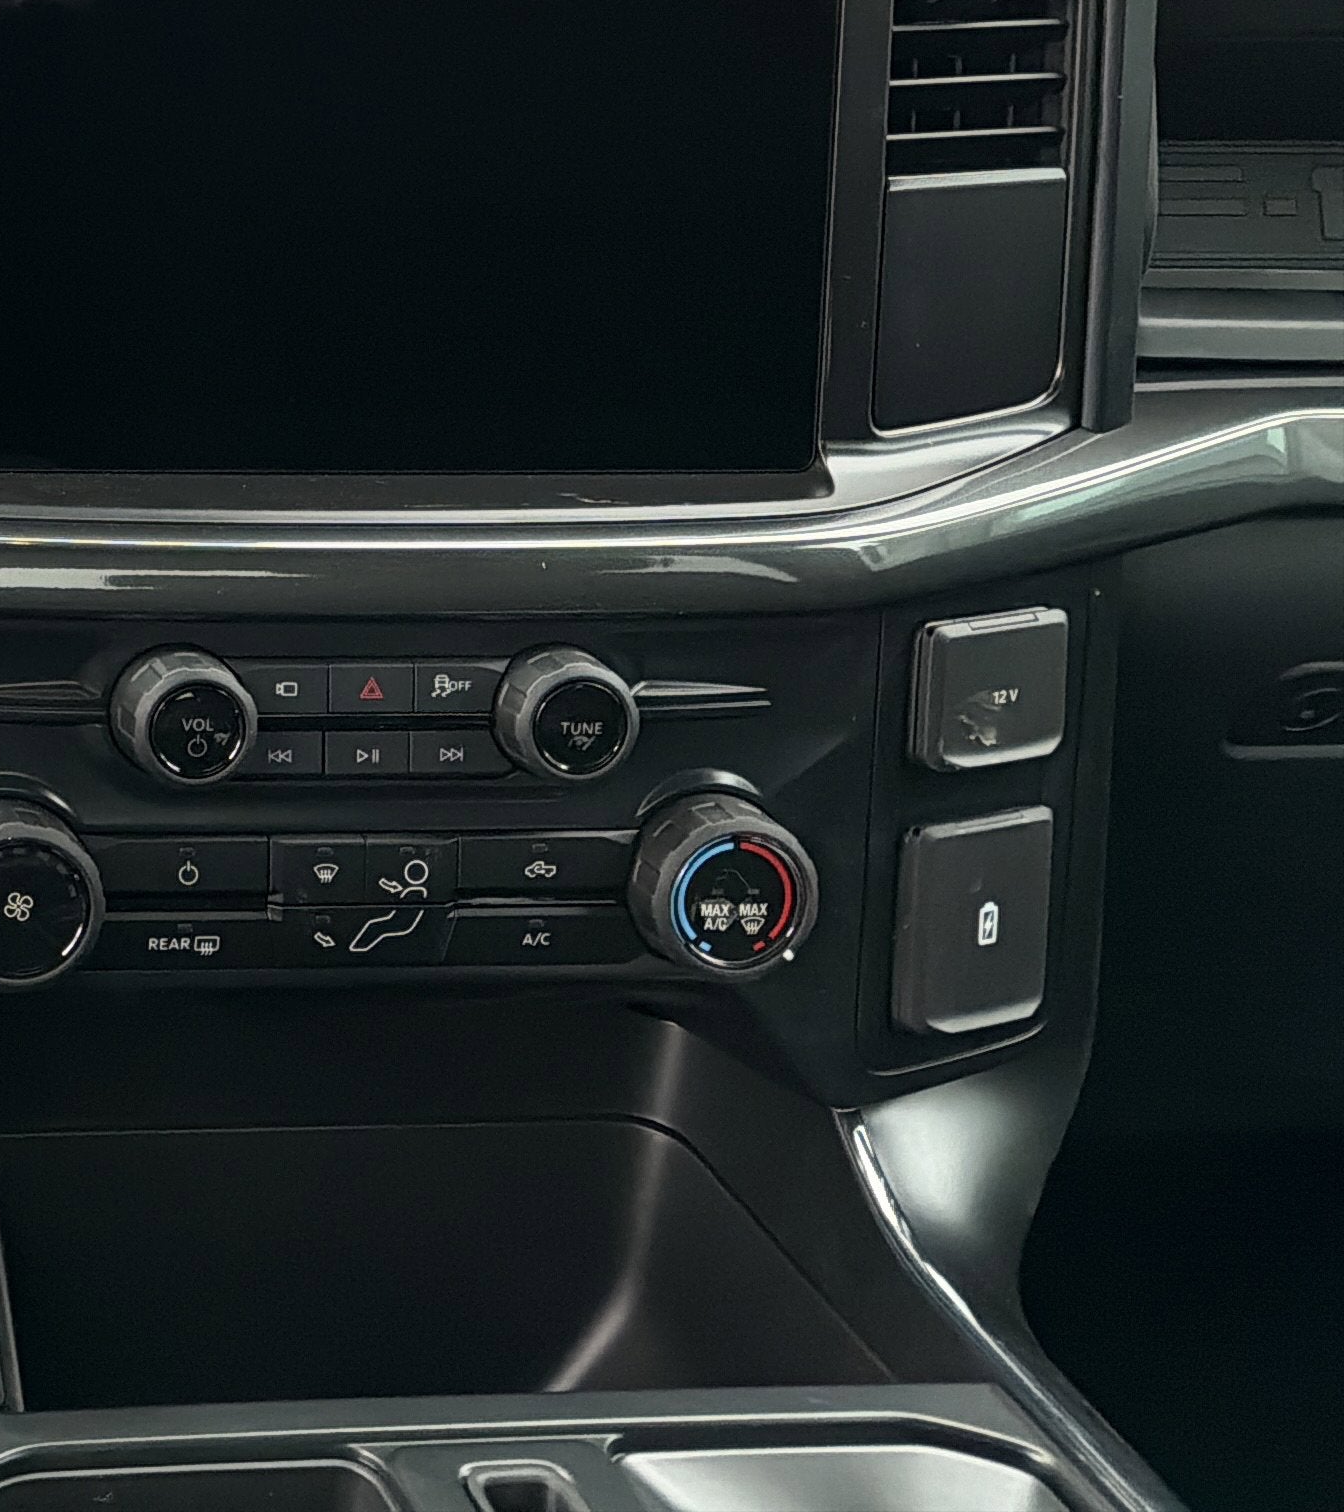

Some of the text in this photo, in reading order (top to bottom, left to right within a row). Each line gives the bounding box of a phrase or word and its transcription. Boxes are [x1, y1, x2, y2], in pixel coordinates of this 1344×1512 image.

[448, 680, 473, 692] OFF
[992, 688, 1019, 705] 12 V
[181, 717, 214, 733] VOL
[561, 721, 604, 736] TUNE
[700, 903, 730, 917] MAX
[738, 902, 768, 917] MAX
[703, 917, 729, 932] A/C
[148, 938, 191, 952] REAR
[521, 932, 552, 948] A/C
